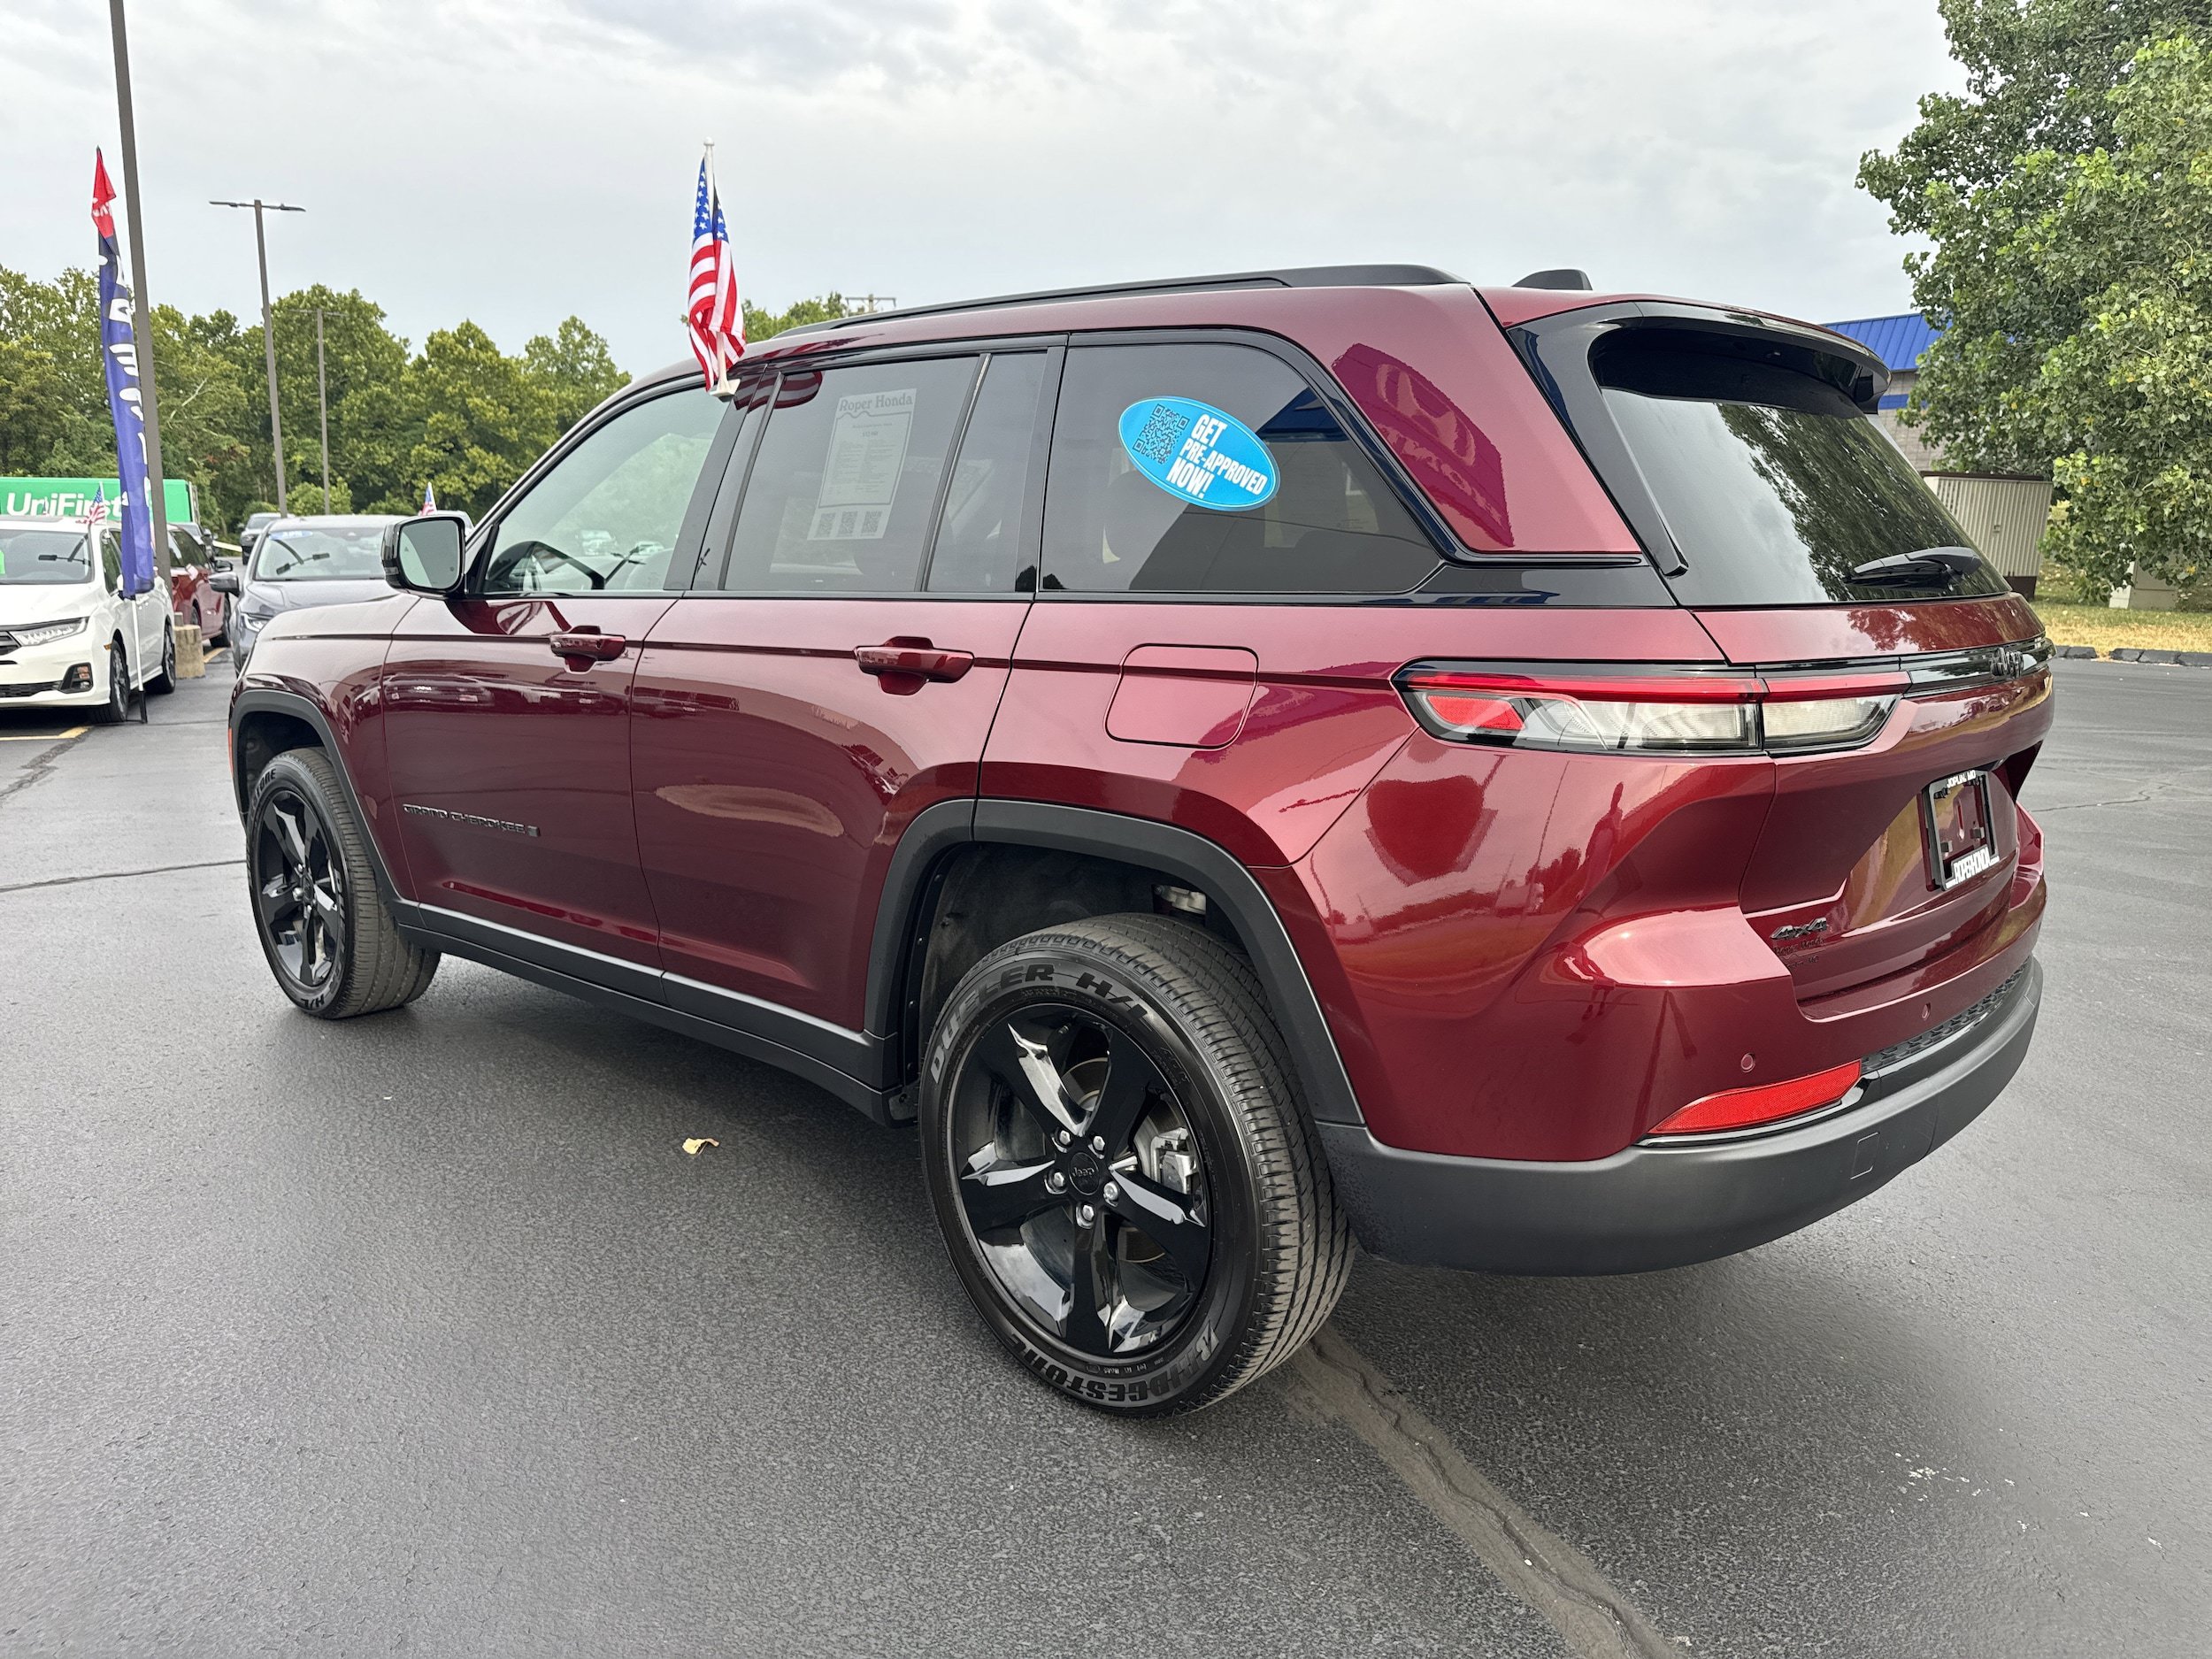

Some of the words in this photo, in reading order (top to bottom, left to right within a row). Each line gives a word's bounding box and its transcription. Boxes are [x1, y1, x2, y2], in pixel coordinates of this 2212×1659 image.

[839, 399, 872, 412] Roper
[875, 393, 913, 408] Honda
[1191, 414, 1227, 447] GET
[1165, 456, 1215, 499] NOW!
[1179, 438, 1268, 495] PRE-APPROVED
[403, 803, 449, 819] GRAND
[450, 811, 526, 834] CHEROKEE
[931, 964, 1055, 1084] DUELER
[1008, 1319, 1220, 1402] BRIDGESTONE
